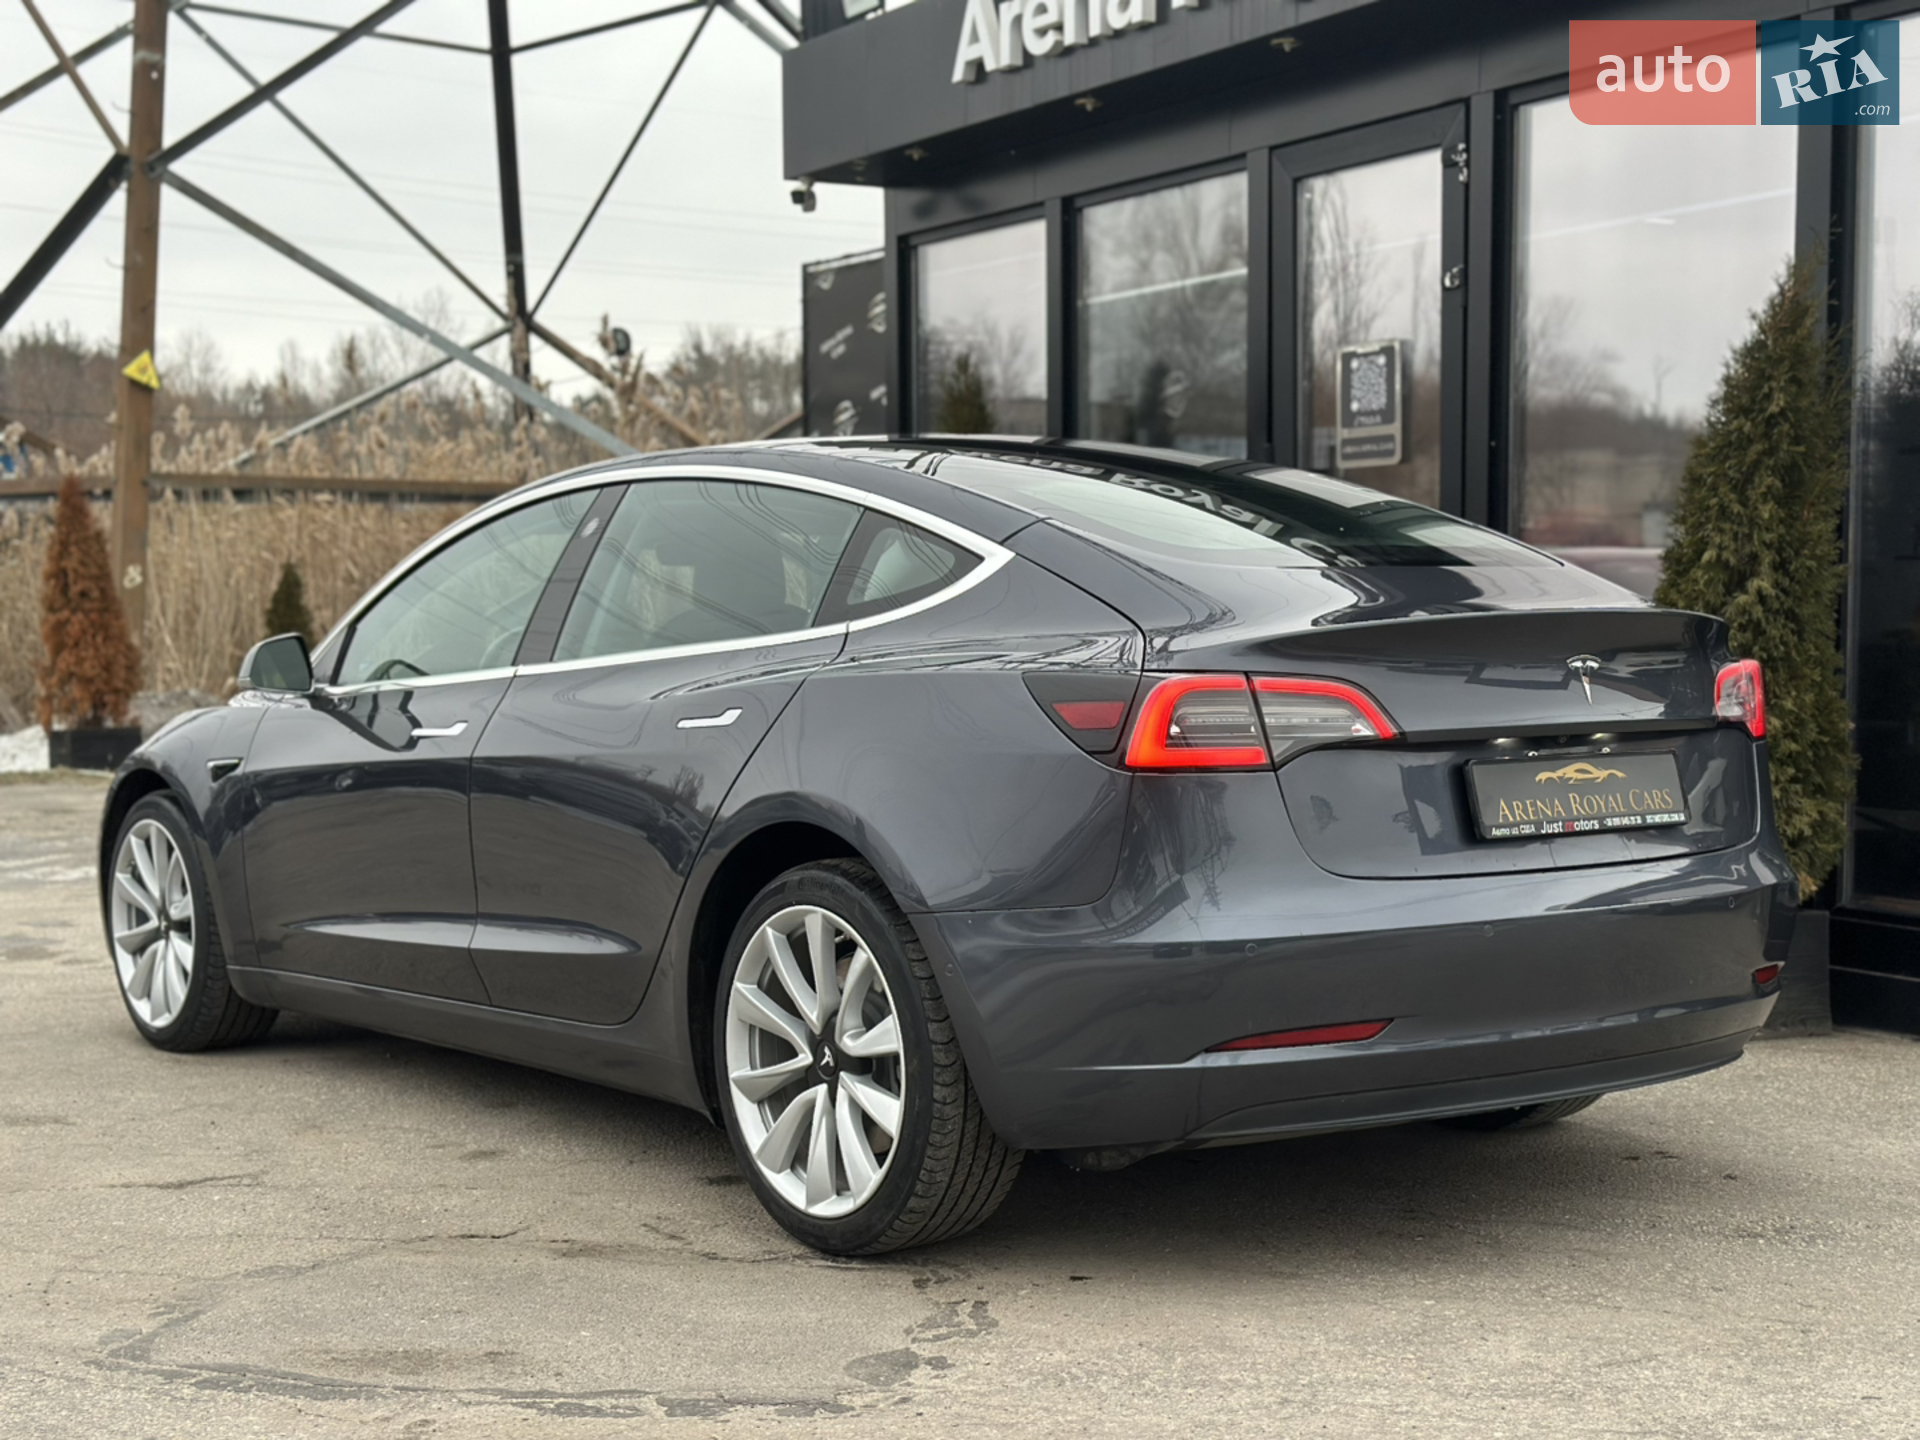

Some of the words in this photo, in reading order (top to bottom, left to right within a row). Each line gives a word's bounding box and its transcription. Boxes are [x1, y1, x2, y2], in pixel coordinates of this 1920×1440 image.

[951, 0, 1156, 84] Arena
[1499, 798, 1566, 823] ARENA
[1568, 792, 1628, 816] ROYAL
[1629, 788, 1675, 812] CARS
